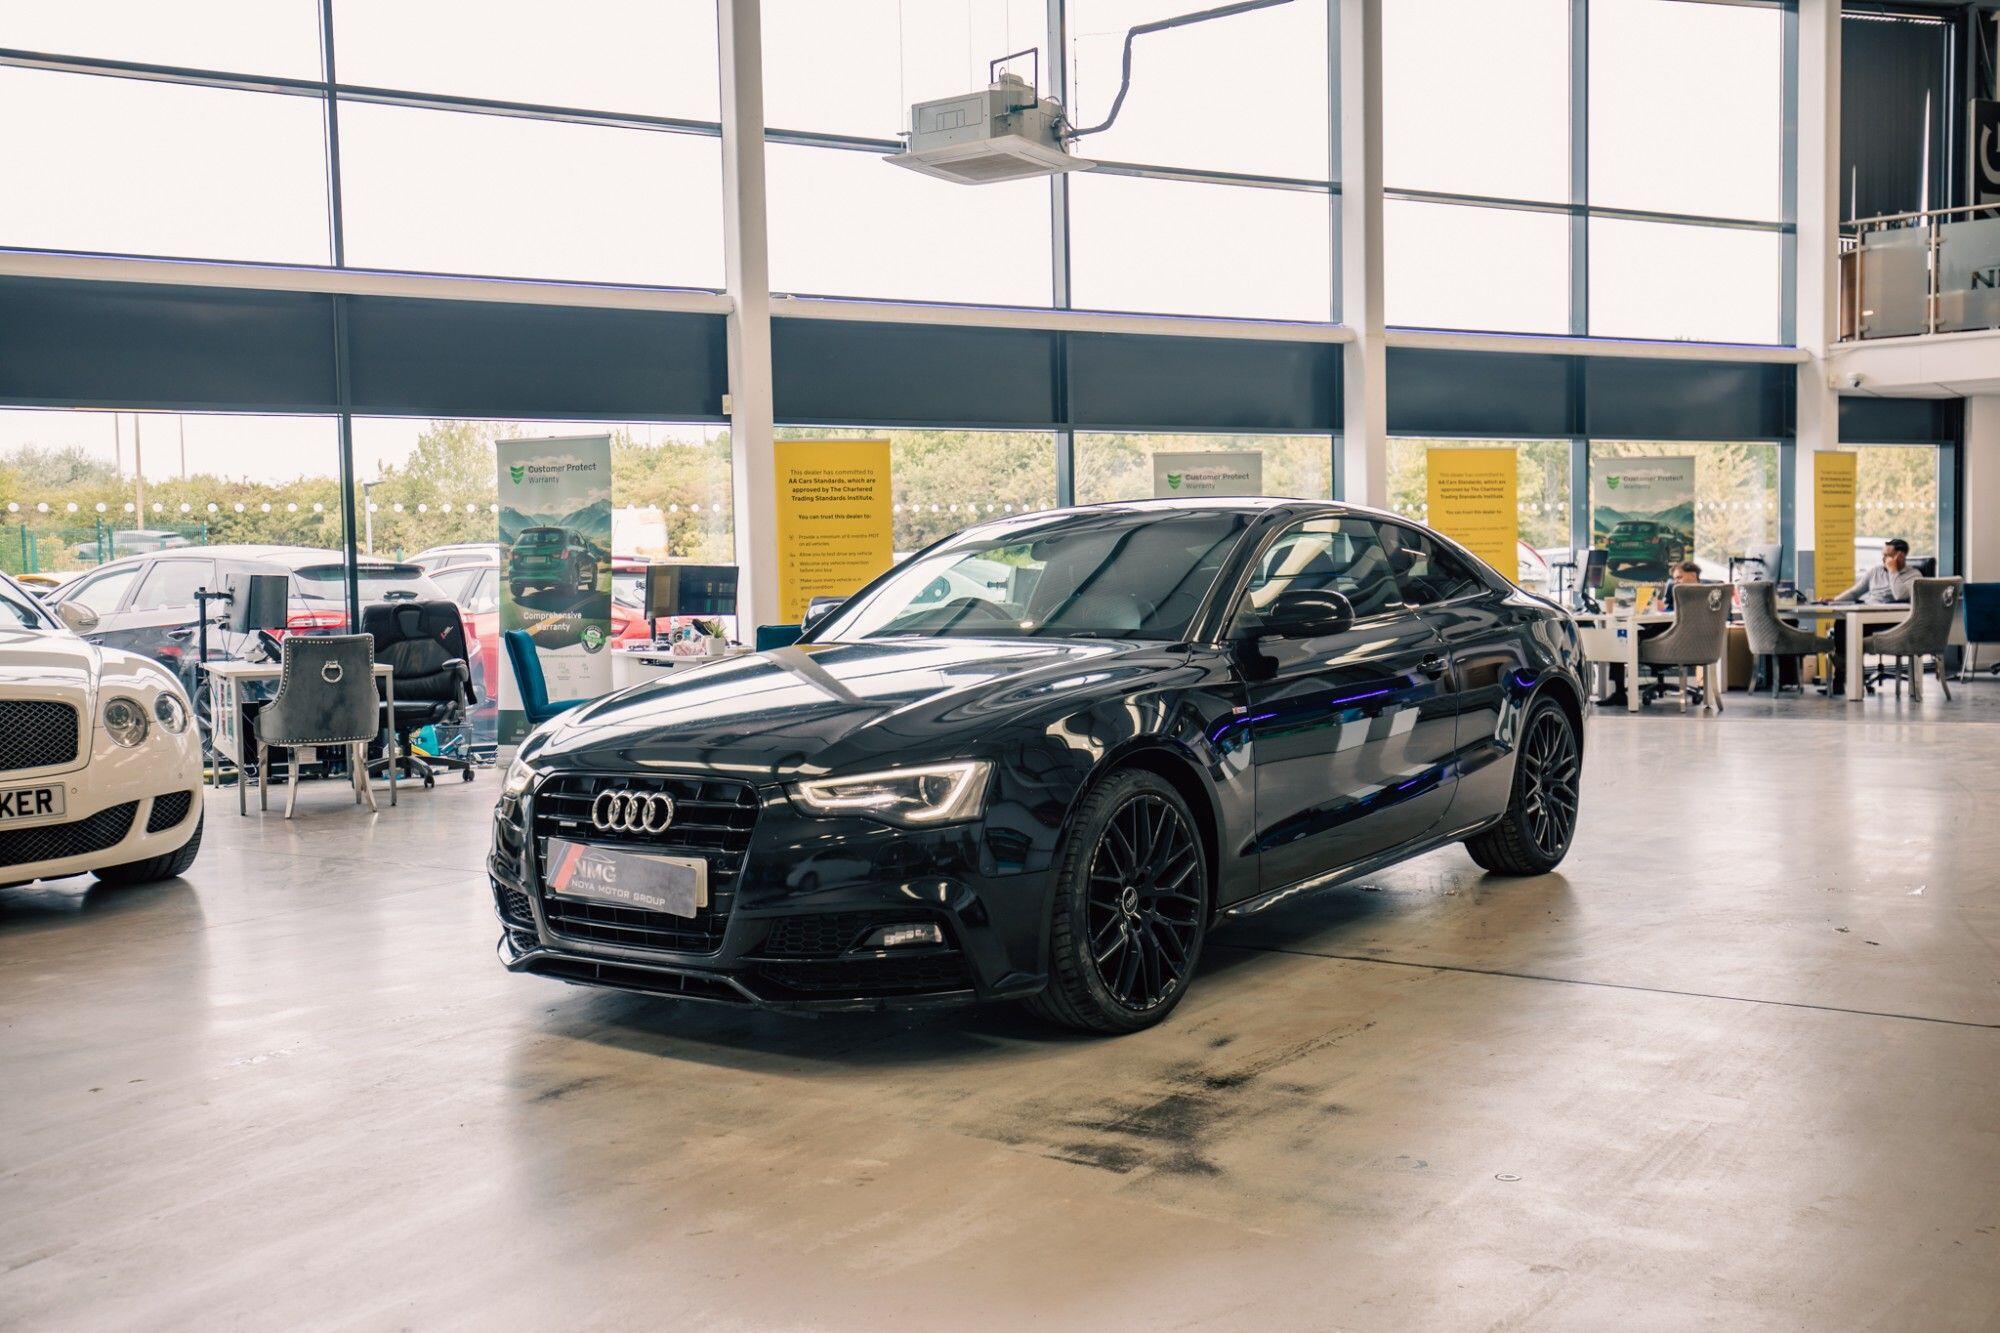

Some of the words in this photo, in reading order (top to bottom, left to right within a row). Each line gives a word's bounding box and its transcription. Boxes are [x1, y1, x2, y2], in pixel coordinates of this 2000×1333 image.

[528, 465, 564, 473] Customer
[566, 463, 597, 472] Protect
[523, 611, 582, 620] Comprehensive
[536, 622, 570, 631] Warranty
[0, 788, 52, 818] KER
[573, 858, 616, 882] NMG
[572, 878, 595, 891] NOVA
[598, 885, 630, 899] MOTOR
[634, 892, 666, 906] GROUP
